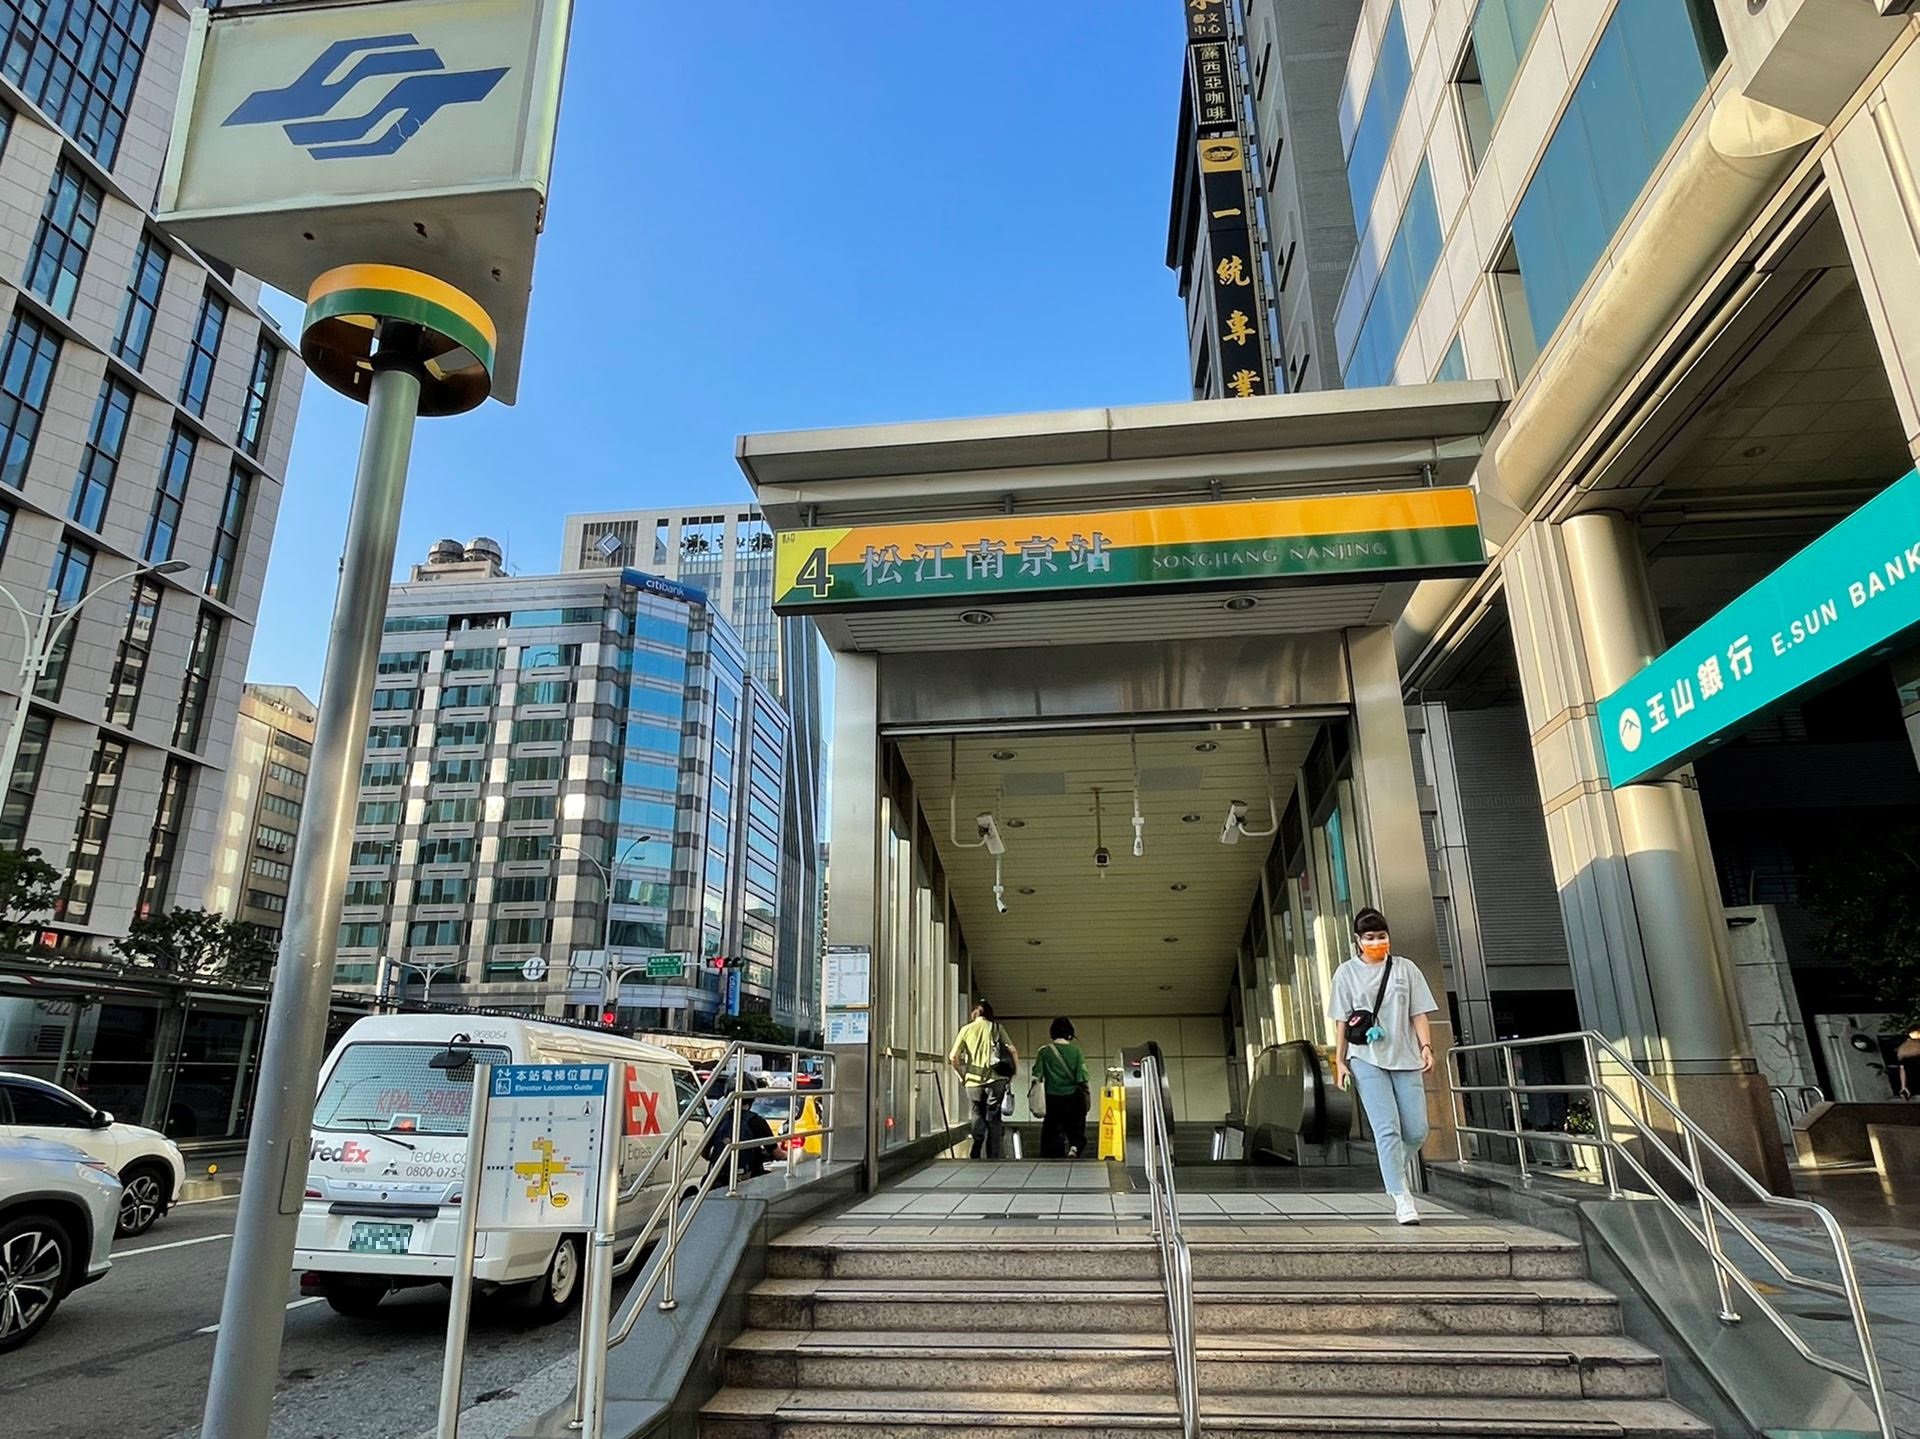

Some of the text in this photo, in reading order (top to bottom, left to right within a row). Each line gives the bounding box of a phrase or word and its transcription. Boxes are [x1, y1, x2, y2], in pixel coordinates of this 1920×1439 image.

[795, 531, 1113, 598] 4 松江南京站
[1152, 541, 1388, 571] SONGJIANG NANJING
[645, 579, 685, 597] citibank
[1771, 541, 1920, 657] E.SUN BANK
[1645, 634, 1754, 734] 玉山銀行
[515, 1083, 593, 1092] Elevator Location Guide
[310, 1137, 371, 1164] FedEx
